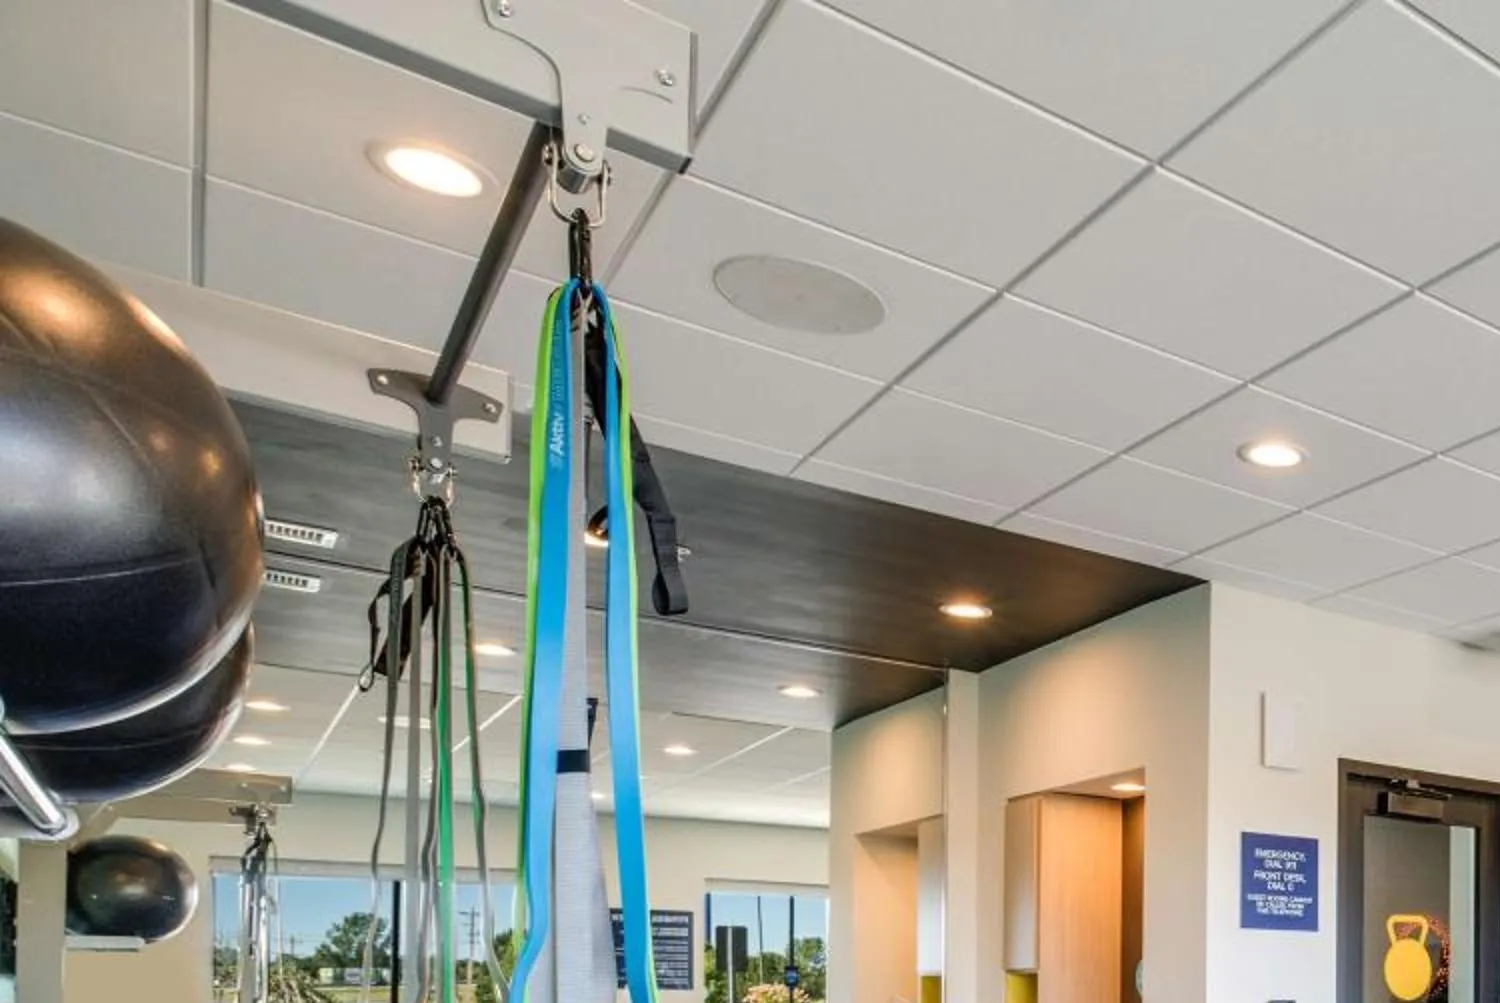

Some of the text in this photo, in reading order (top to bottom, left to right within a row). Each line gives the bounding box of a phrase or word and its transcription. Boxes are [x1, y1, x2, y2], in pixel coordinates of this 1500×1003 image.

[551, 410, 566, 457] Aktiv
[1253, 870, 1281, 881] FRONT
[1266, 881, 1286, 891] DIAL
